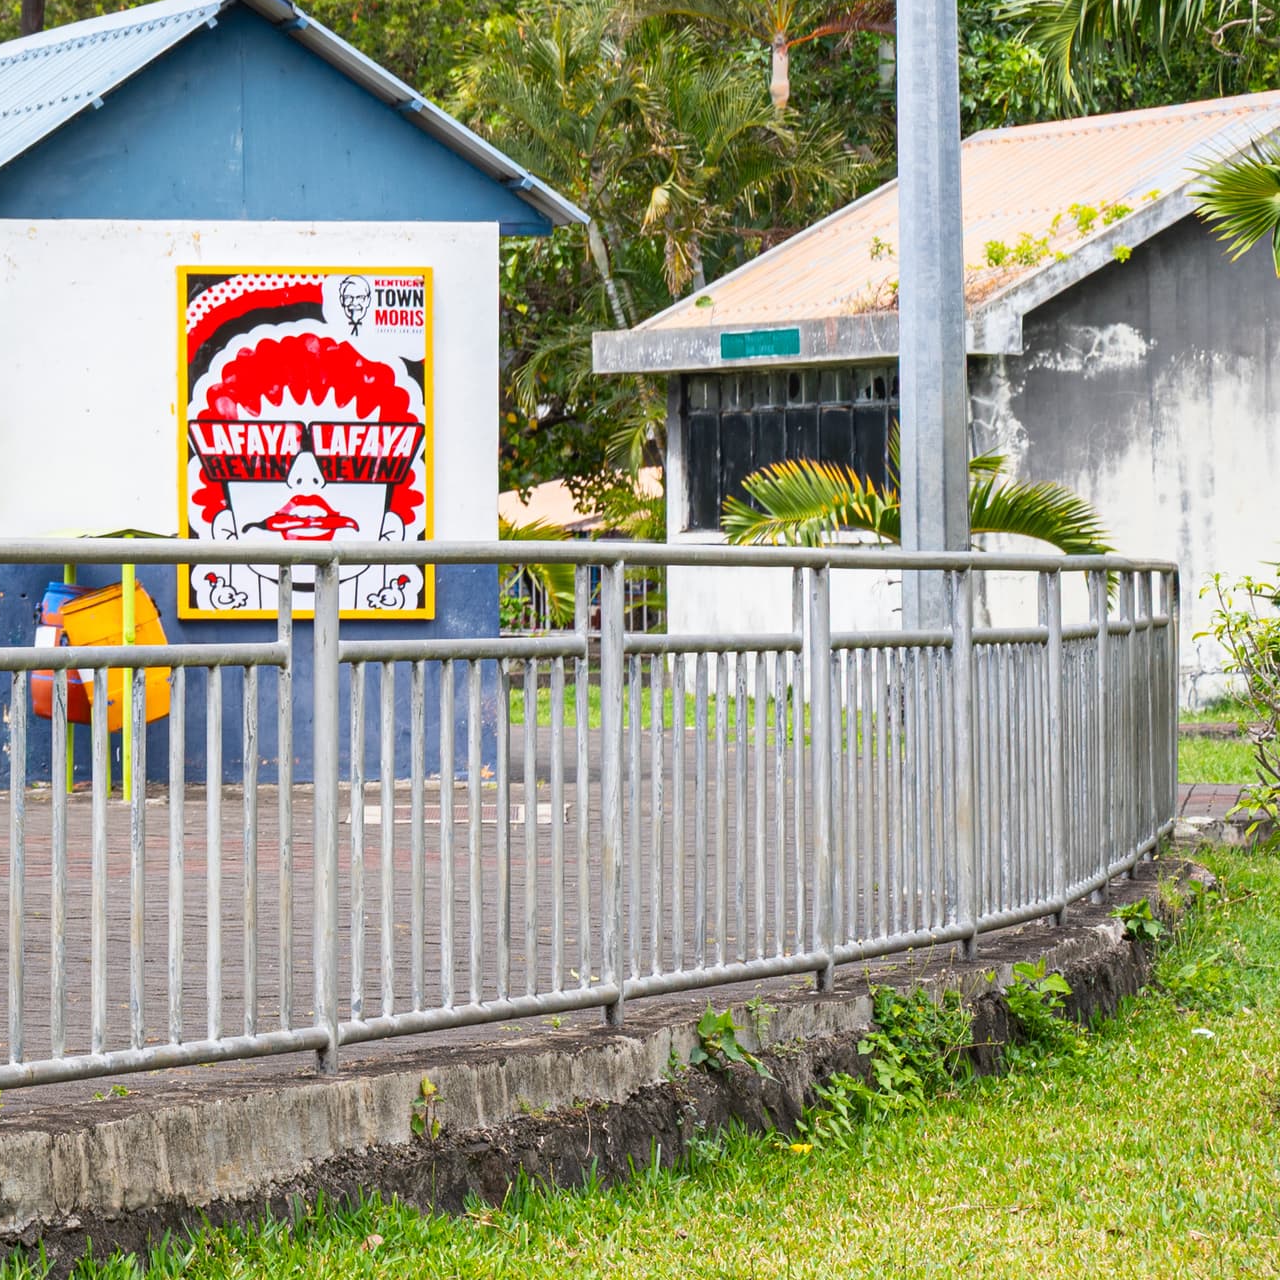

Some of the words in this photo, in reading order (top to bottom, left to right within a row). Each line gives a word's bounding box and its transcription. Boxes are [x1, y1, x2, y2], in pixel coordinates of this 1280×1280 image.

[375, 279, 424, 287] KENTUCKY
[375, 289, 424, 308] TOWN
[375, 309, 424, 326] MORIS
[191, 423, 298, 456] LAFAYA
[312, 424, 417, 458] LAFAYA
